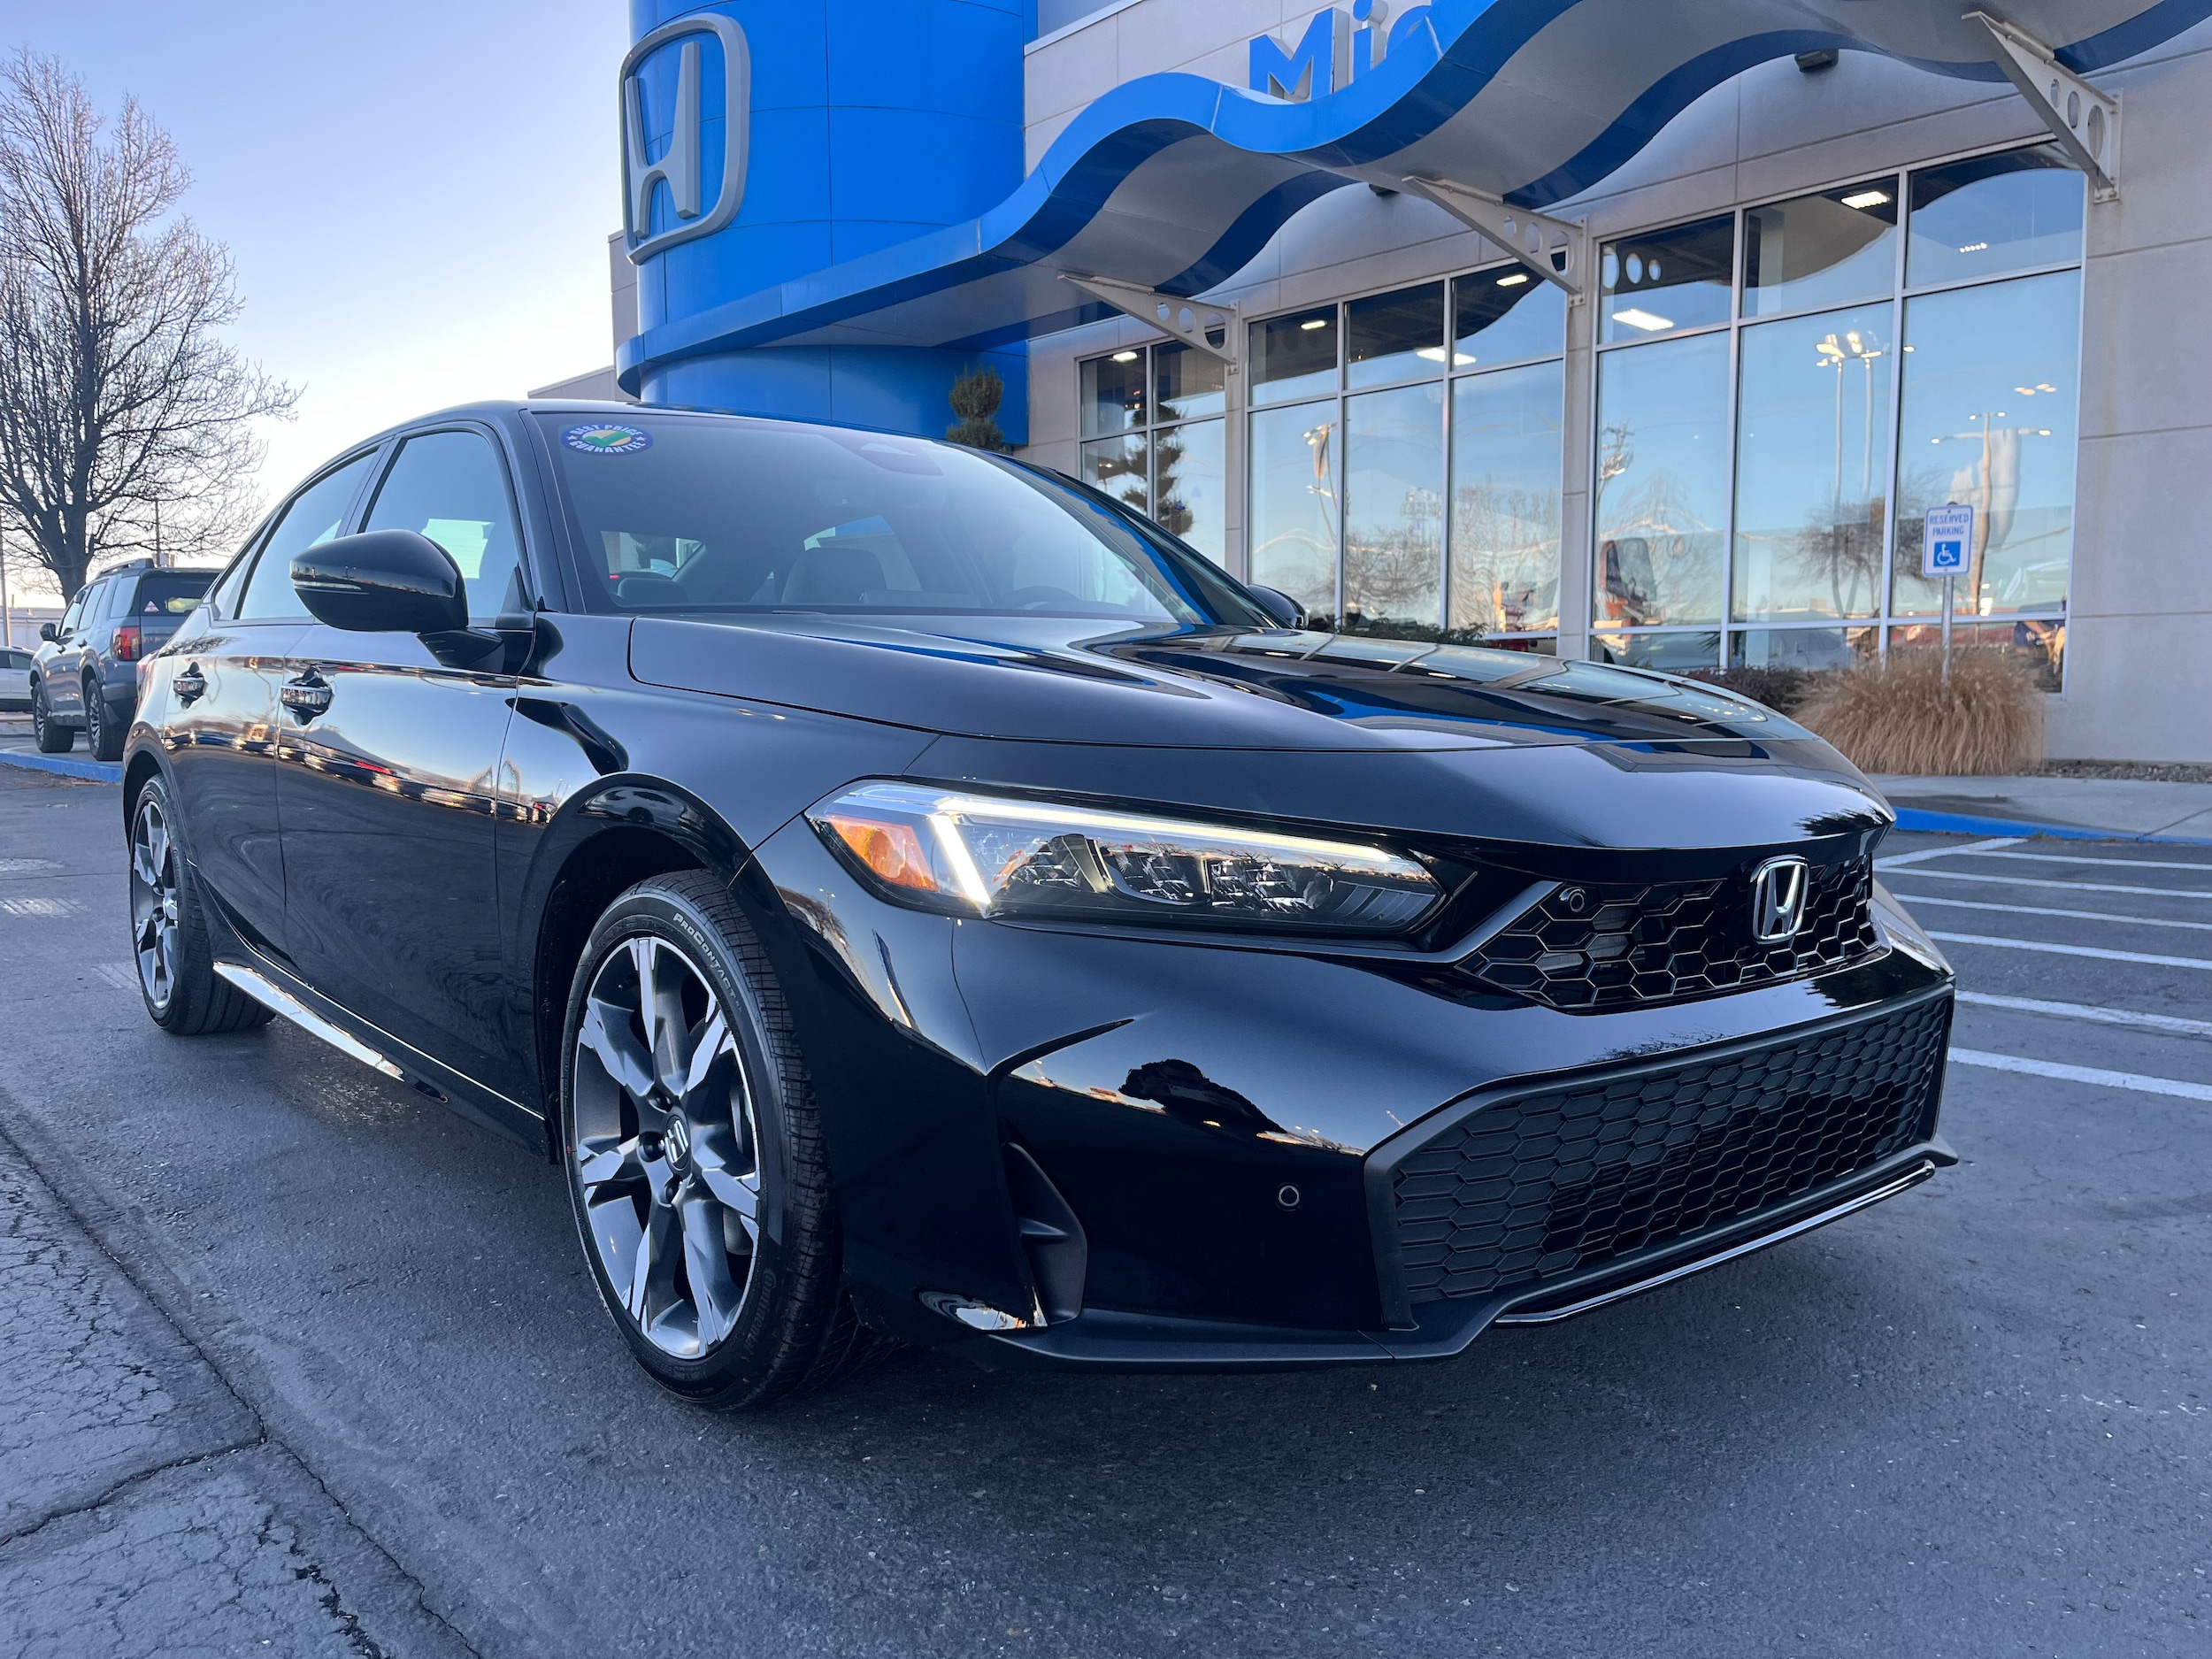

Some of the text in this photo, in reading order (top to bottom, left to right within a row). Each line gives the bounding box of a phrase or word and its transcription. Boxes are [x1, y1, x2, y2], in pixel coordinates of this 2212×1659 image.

[568, 425, 644, 436] BEST PRICE
[568, 441, 646, 453] GUARANTEE
[1930, 513, 1969, 524] RESERVED
[1932, 526, 1964, 536] PARKING
